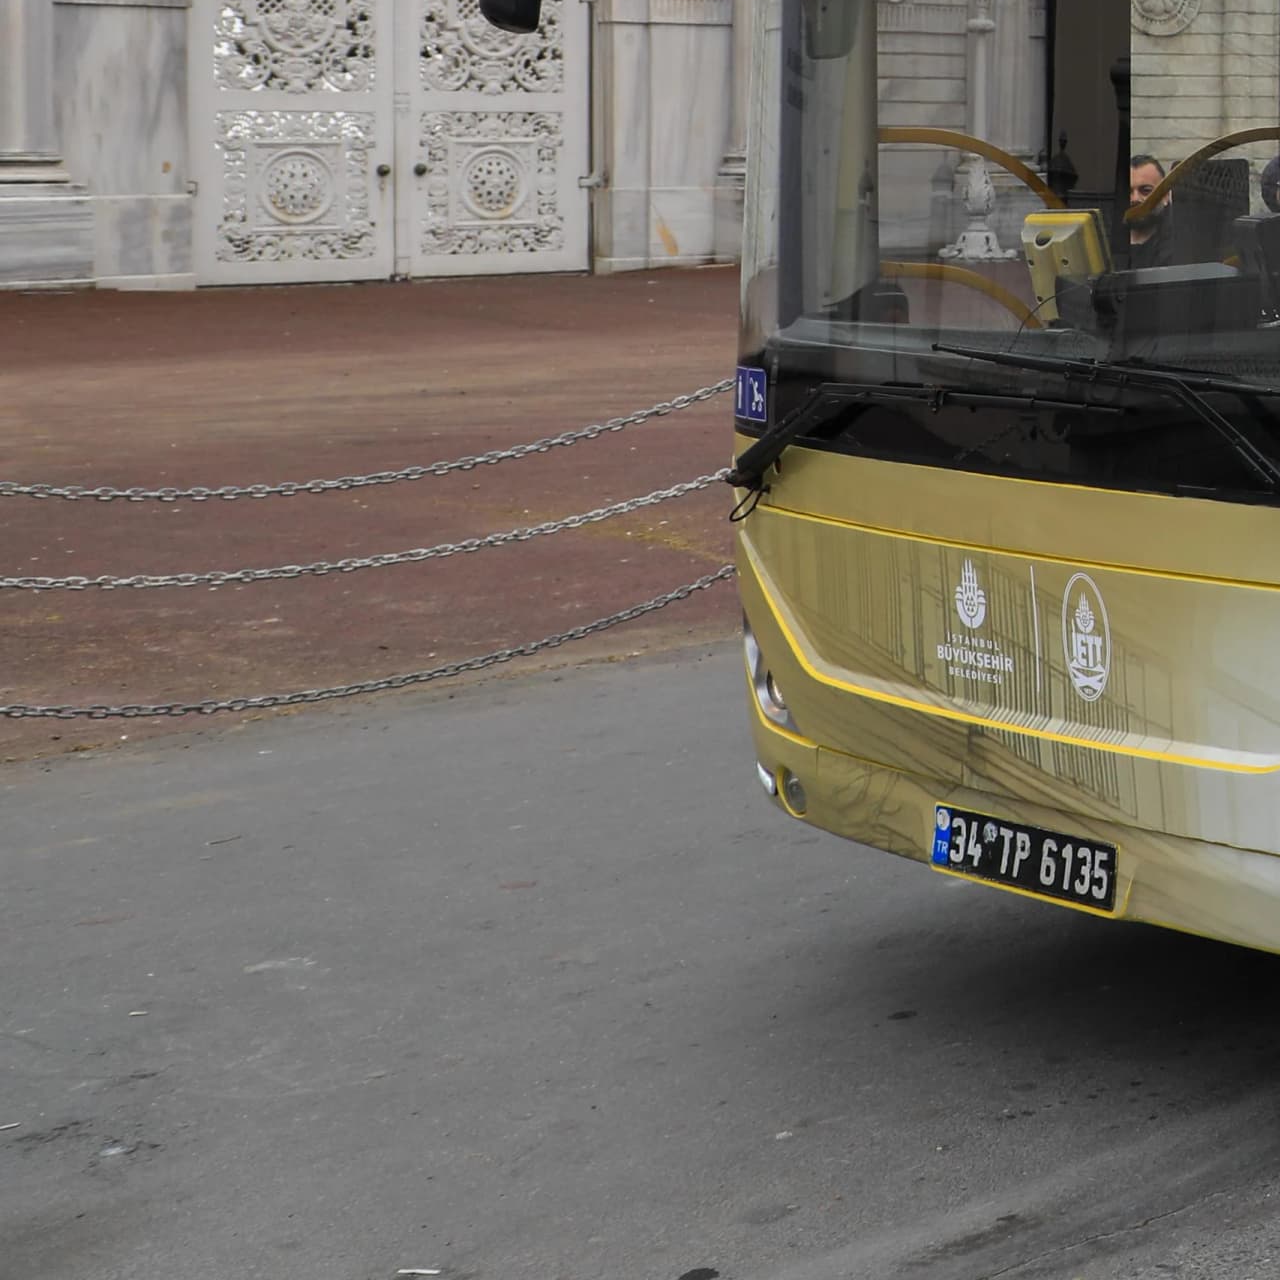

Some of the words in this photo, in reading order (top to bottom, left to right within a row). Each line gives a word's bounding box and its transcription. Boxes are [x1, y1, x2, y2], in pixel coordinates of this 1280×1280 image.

[937, 839, 948, 854] TR
[949, 817, 982, 867] 34
[999, 826, 1031, 878] TP
[1039, 838, 1110, 900] 6135
